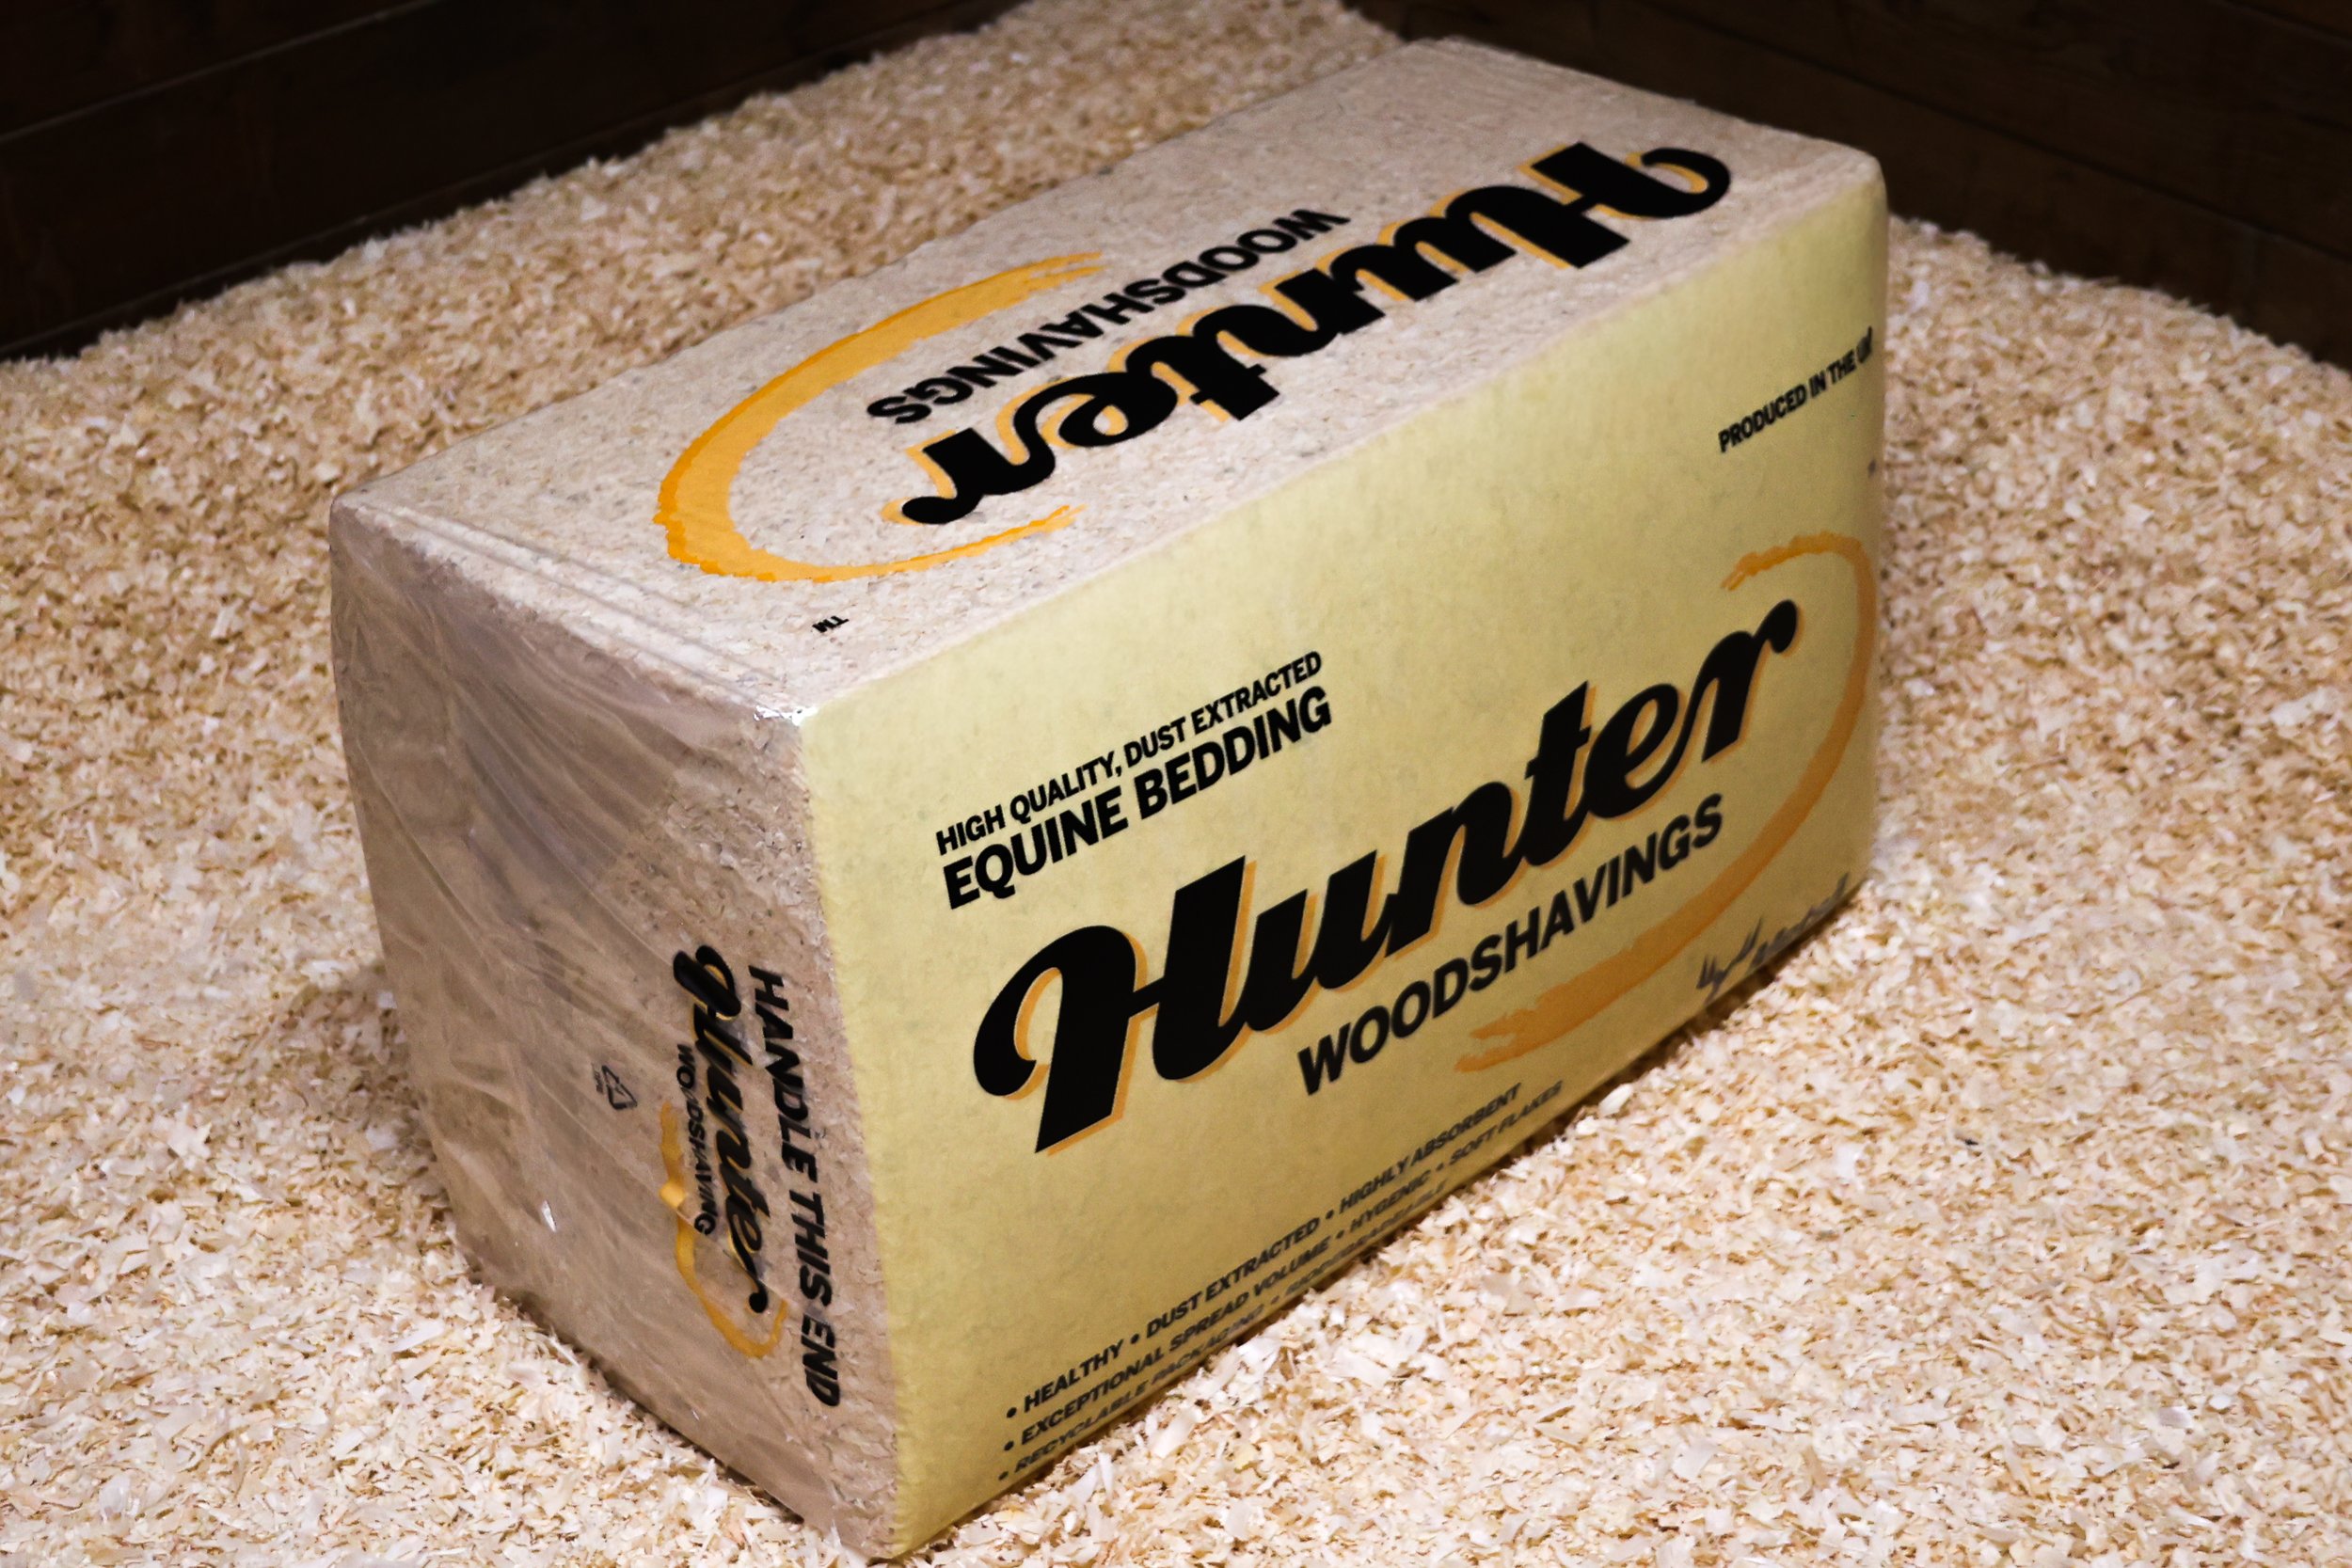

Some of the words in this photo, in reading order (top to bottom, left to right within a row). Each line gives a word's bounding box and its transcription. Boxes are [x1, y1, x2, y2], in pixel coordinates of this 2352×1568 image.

[867, 208, 1352, 424] WOODSHAVINGS
[882, 141, 1732, 525] Hunter
[1718, 384, 1807, 453] PRODUCED
[1808, 370, 1827, 399] IN
[1827, 349, 1857, 384] THE
[935, 804, 1006, 856] HIGH
[1009, 751, 1122, 824] QUALITY,
[1123, 716, 1186, 768] DUST
[1191, 651, 1323, 735] EXTRACTED
[943, 786, 1129, 910] EQUINE
[1134, 686, 1332, 819] BEDDING
[972, 598, 1801, 1156] Hunter
[1297, 793, 1723, 1096] WOODSHAVINGS
[672, 945, 771, 1314] Hunter
[749, 965, 818, 1183] HANDLE
[789, 1189, 833, 1307] THIS
[1021, 1346, 1165, 1445] EXCEPTIONAL
[1169, 1291, 1250, 1352] SPREAD
[1253, 1235, 1332, 1296] VOLUME
[1448, 1125, 1498, 1166] SOFT
[1024, 1338, 1125, 1412] HEALTHY
[1147, 1291, 1202, 1338] DUST
[1204, 1217, 1321, 1302] EXTRACTED
[1339, 1157, 1409, 1214] HIGHLY
[1410, 1082, 1522, 1166] ABSORBENT
[801, 1313, 840, 1407] END
